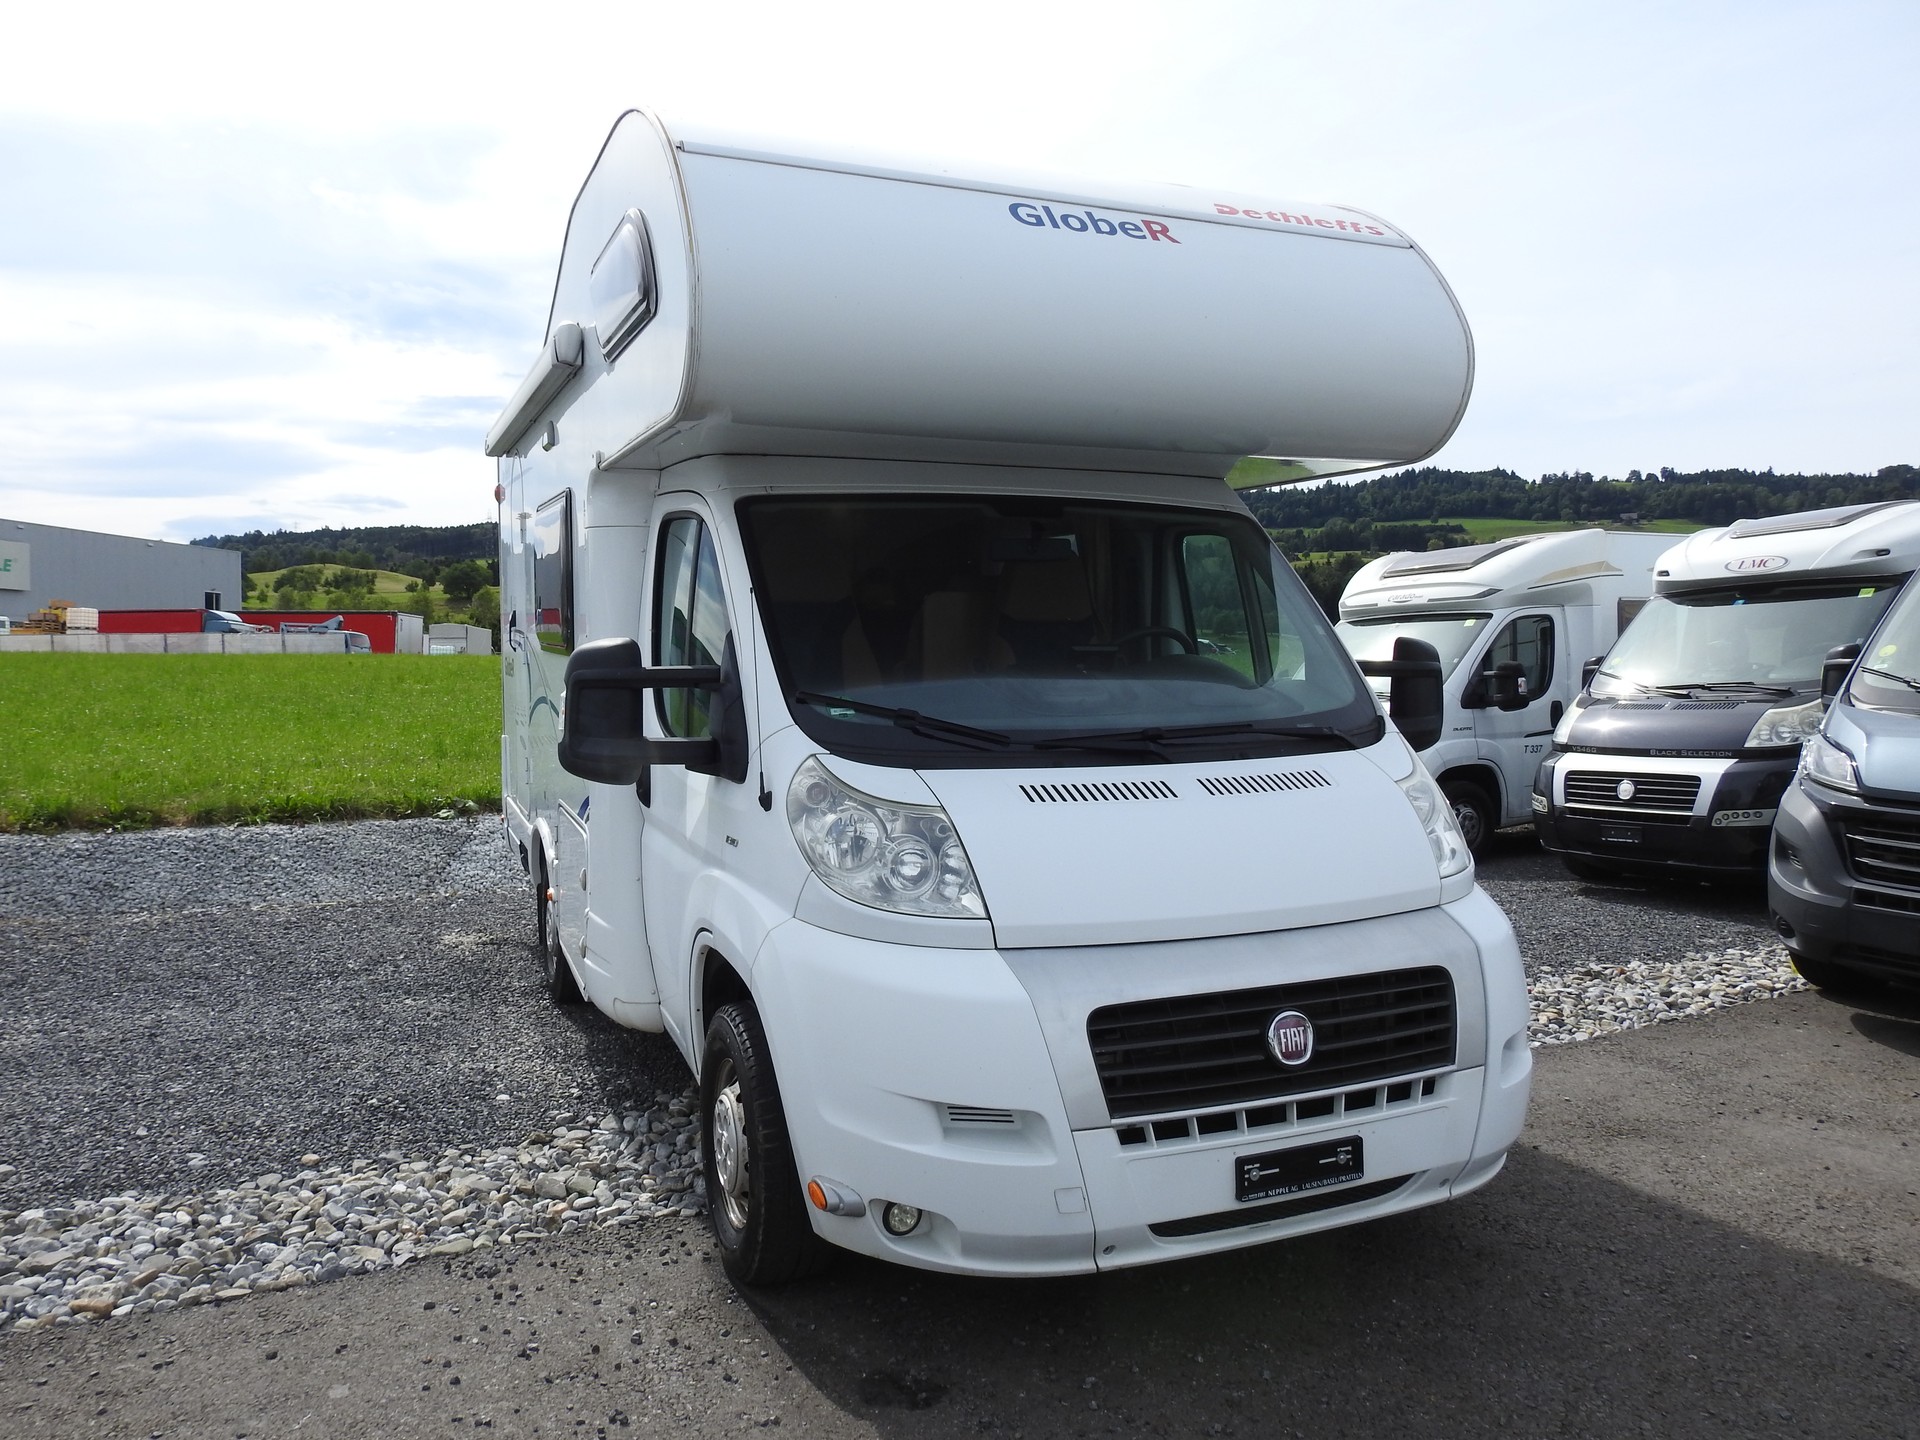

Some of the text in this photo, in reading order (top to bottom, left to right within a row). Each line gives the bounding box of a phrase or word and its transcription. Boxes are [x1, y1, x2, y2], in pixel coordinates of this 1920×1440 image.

[1008, 202, 1182, 245] GlobeR
[1213, 203, 1386, 237] Dethleffs
[1737, 557, 1775, 570] LMC
[1523, 744, 1543, 754] T 337
[1279, 1026, 1305, 1053] FIAT
